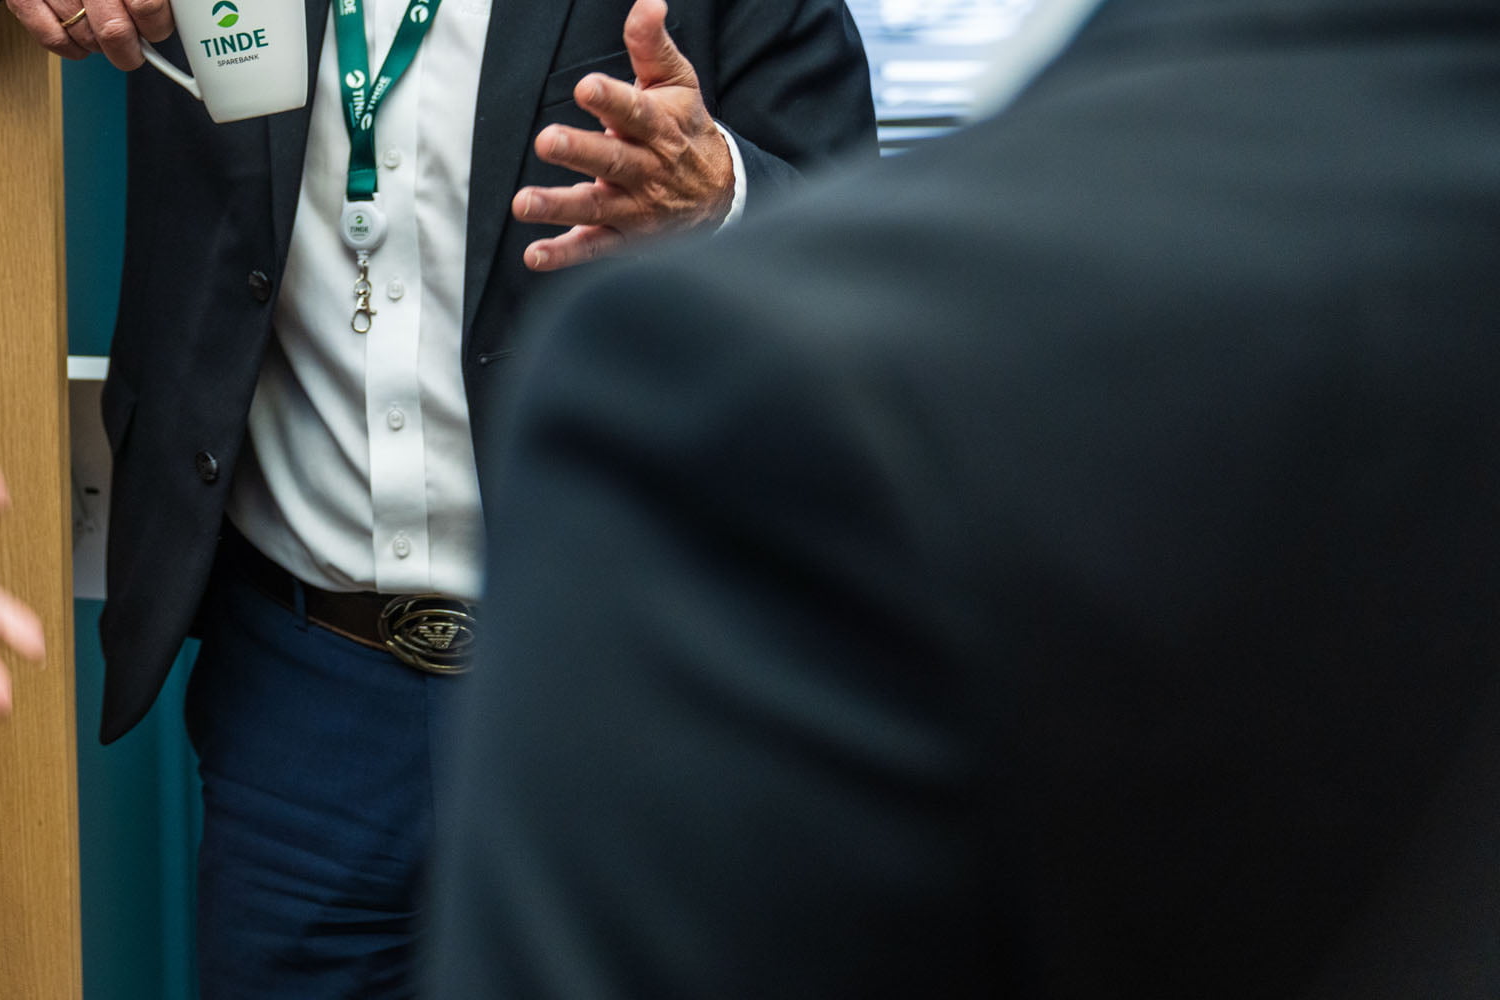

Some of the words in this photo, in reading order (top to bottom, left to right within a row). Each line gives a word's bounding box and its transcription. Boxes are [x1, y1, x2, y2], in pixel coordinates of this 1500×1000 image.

[200, 28, 269, 58] TINDE
[217, 54, 260, 67] SPAREBANK
[353, 88, 366, 124] TIN
[366, 75, 389, 111] TINDE
